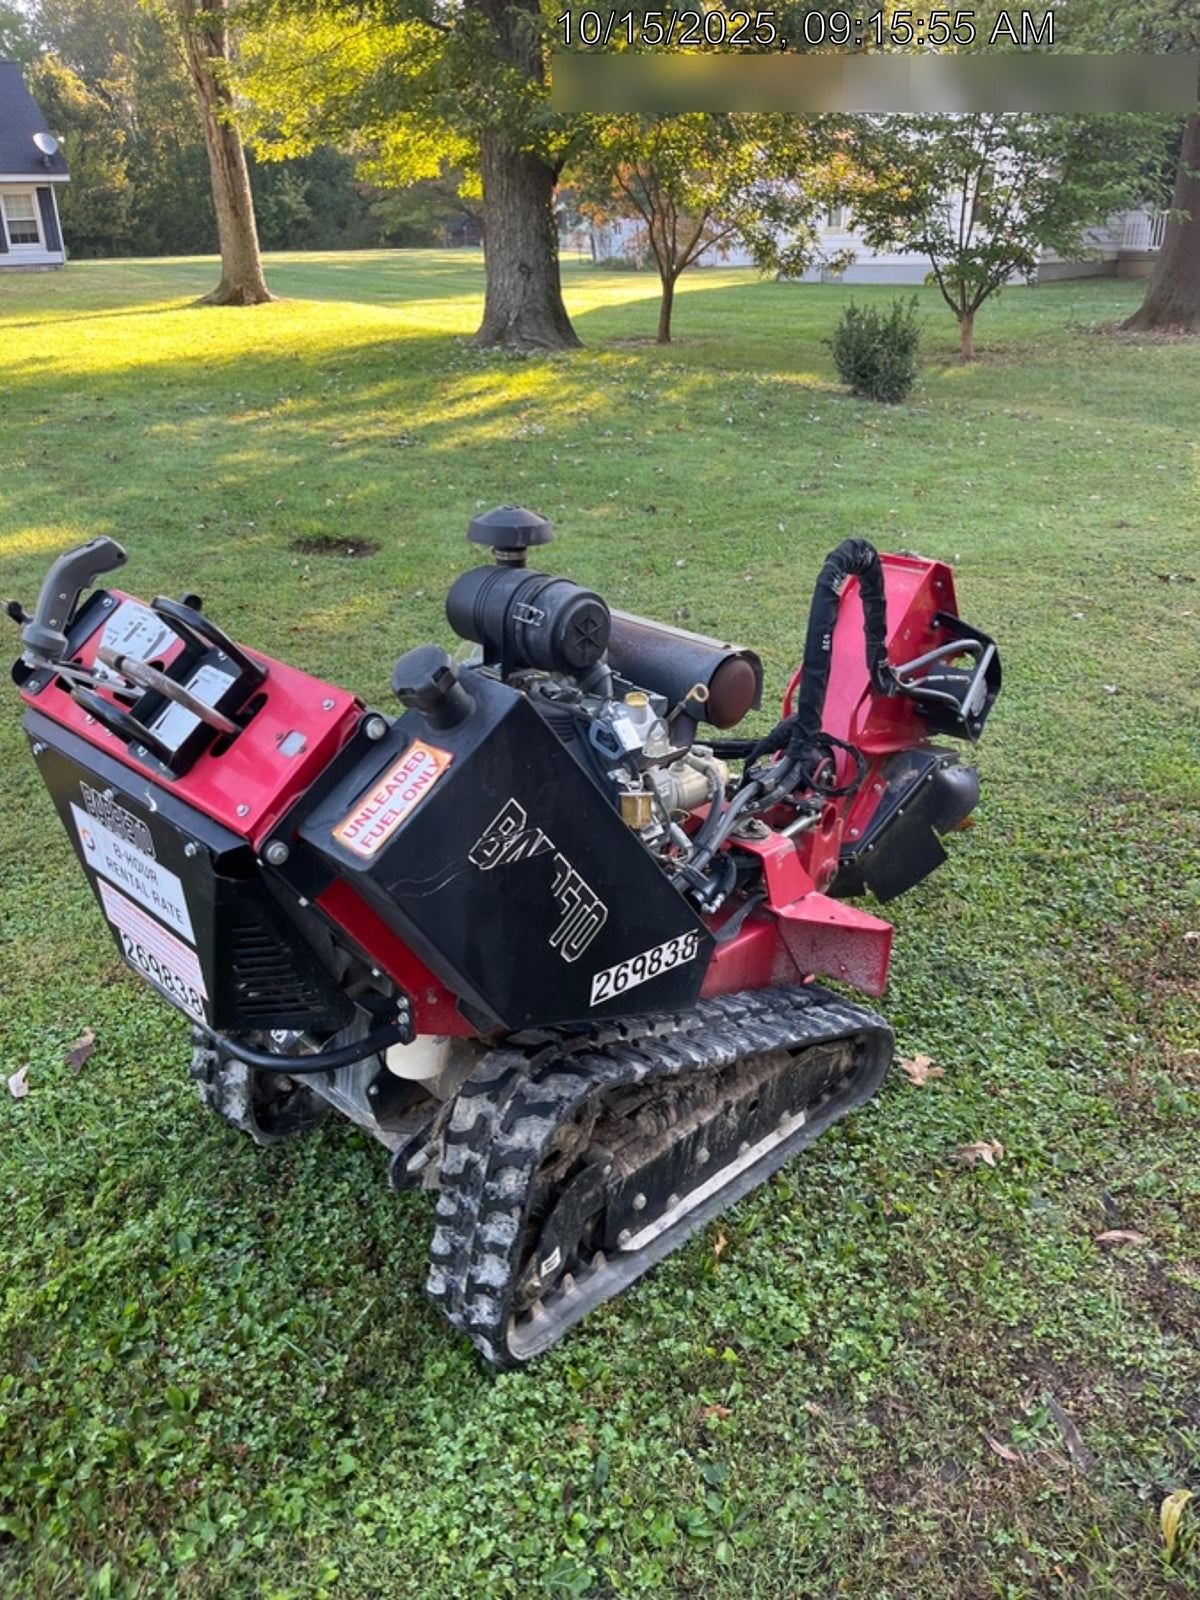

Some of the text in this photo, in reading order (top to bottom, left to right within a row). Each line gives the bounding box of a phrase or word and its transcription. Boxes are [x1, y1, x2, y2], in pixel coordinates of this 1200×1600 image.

[343, 750, 427, 839] UNLEADED
[360, 757, 441, 849] FUEL ONLY
[105, 857, 184, 924] RENTAL RATE
[113, 842, 158, 885] 8-HOUR
[123, 933, 203, 1017] 269838
[593, 930, 698, 1003] 269838
